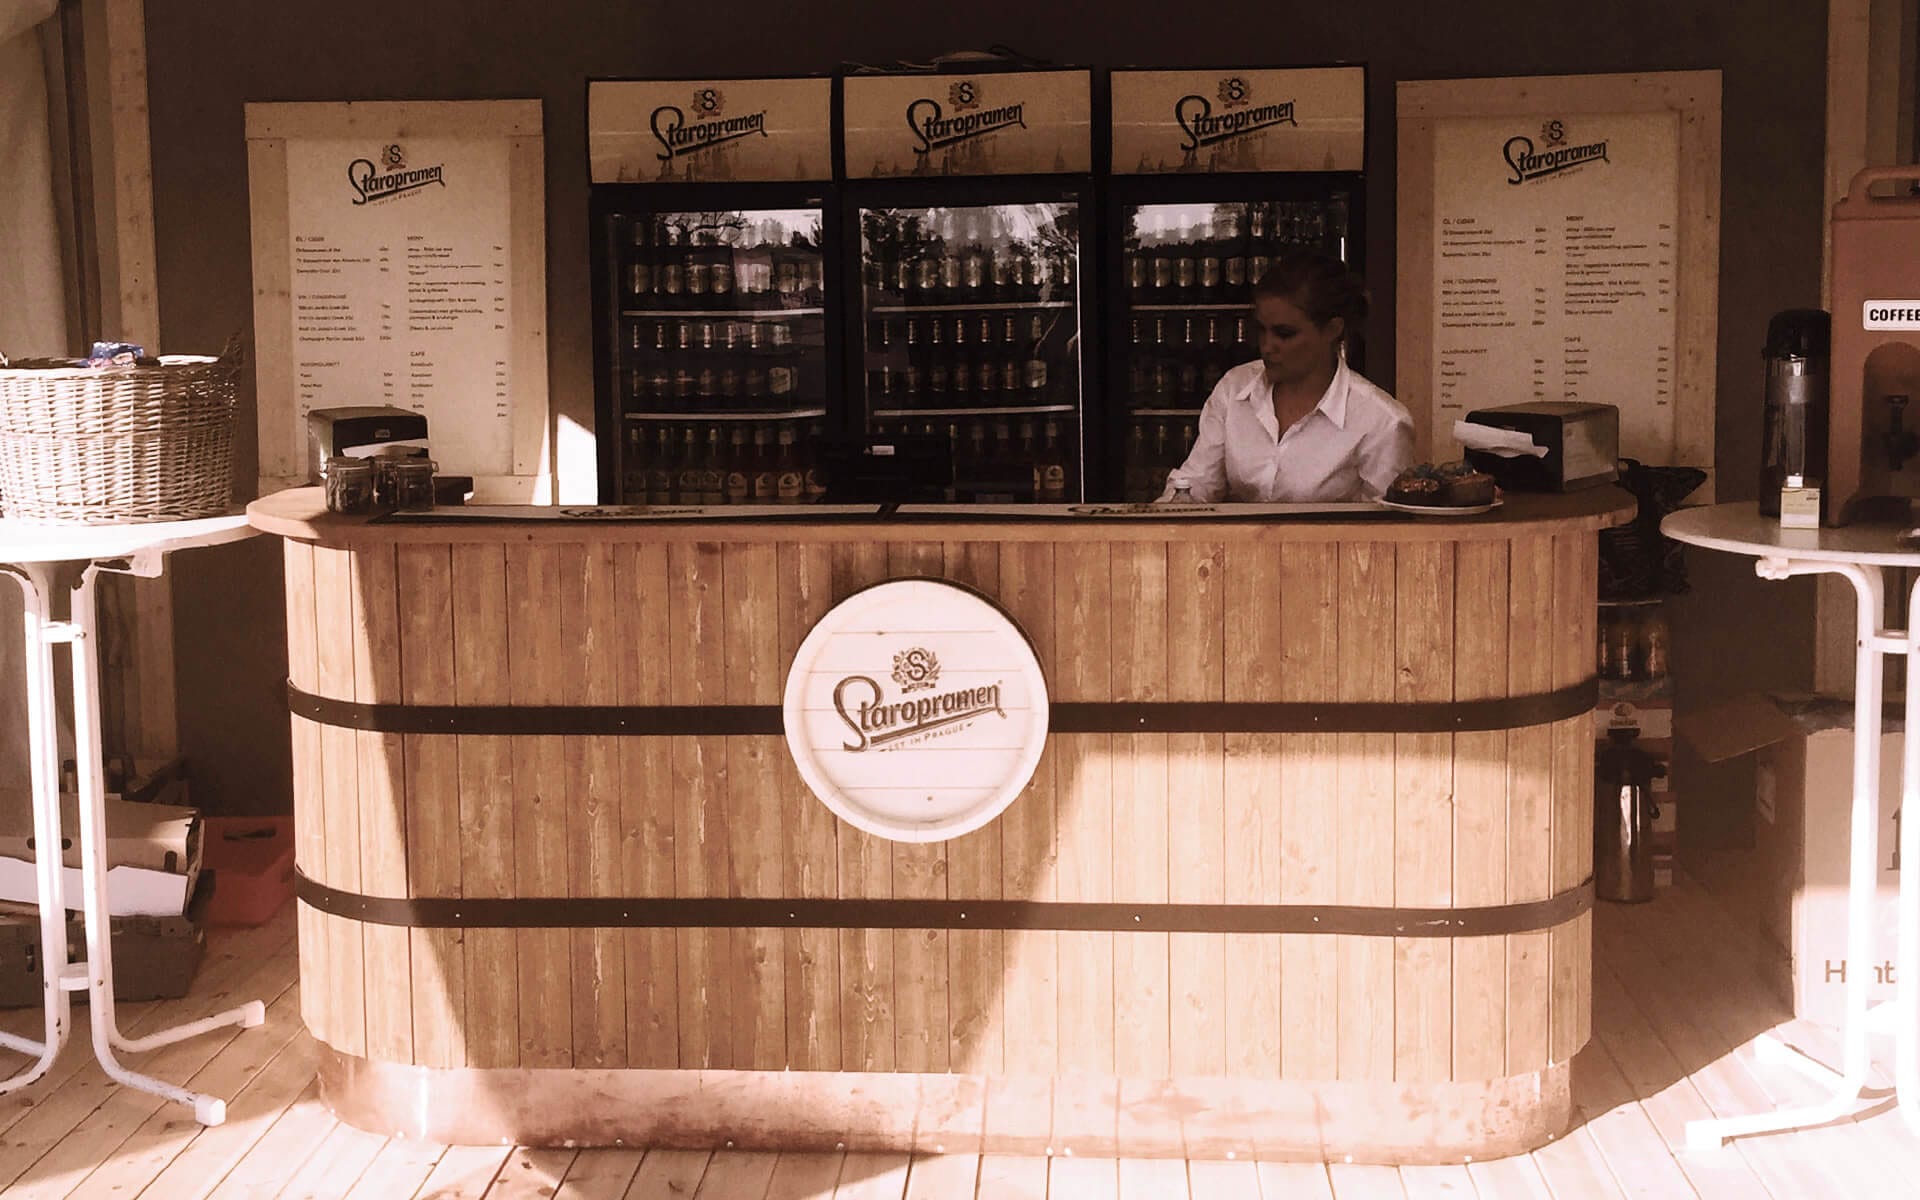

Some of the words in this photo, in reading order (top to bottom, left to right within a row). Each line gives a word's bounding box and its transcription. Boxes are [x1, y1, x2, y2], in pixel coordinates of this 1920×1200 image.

[650, 106, 768, 161] Staropramen
[906, 98, 1027, 153] Staropramen
[1175, 95, 1299, 151] Staropramen
[348, 158, 446, 205] Staropramen
[1503, 136, 1610, 185] Staropramen
[1870, 308, 1920, 321] COFFEE
[833, 675, 1007, 752] Staropramen
[924, 722, 964, 741] PRAGUE
